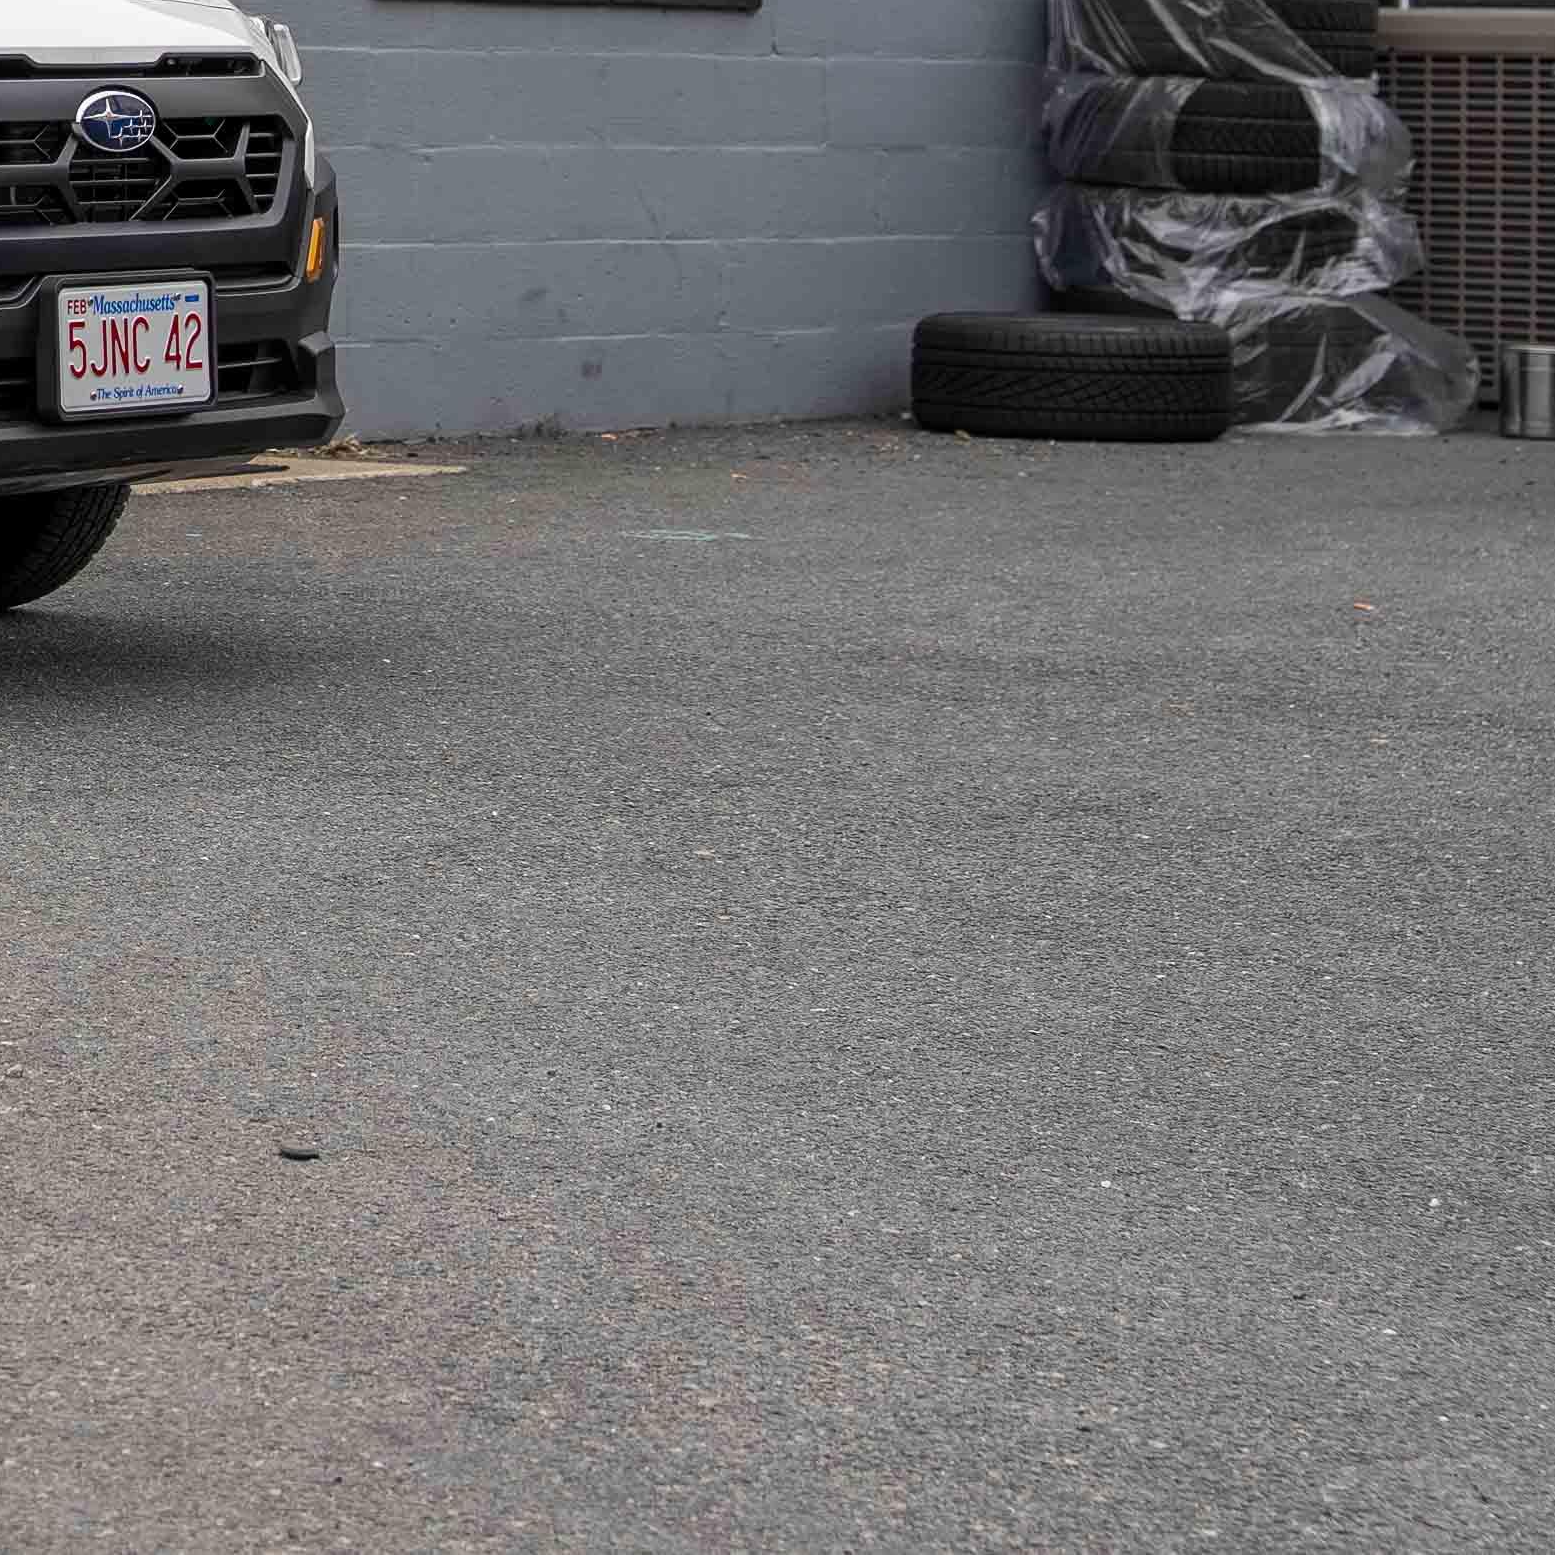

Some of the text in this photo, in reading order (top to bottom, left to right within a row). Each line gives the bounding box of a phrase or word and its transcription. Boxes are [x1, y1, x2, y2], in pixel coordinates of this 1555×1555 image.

[67, 292, 175, 315] FEB Massachusetts
[68, 311, 203, 379] 5JNC 42
[96, 383, 177, 402] The Spirit of America
